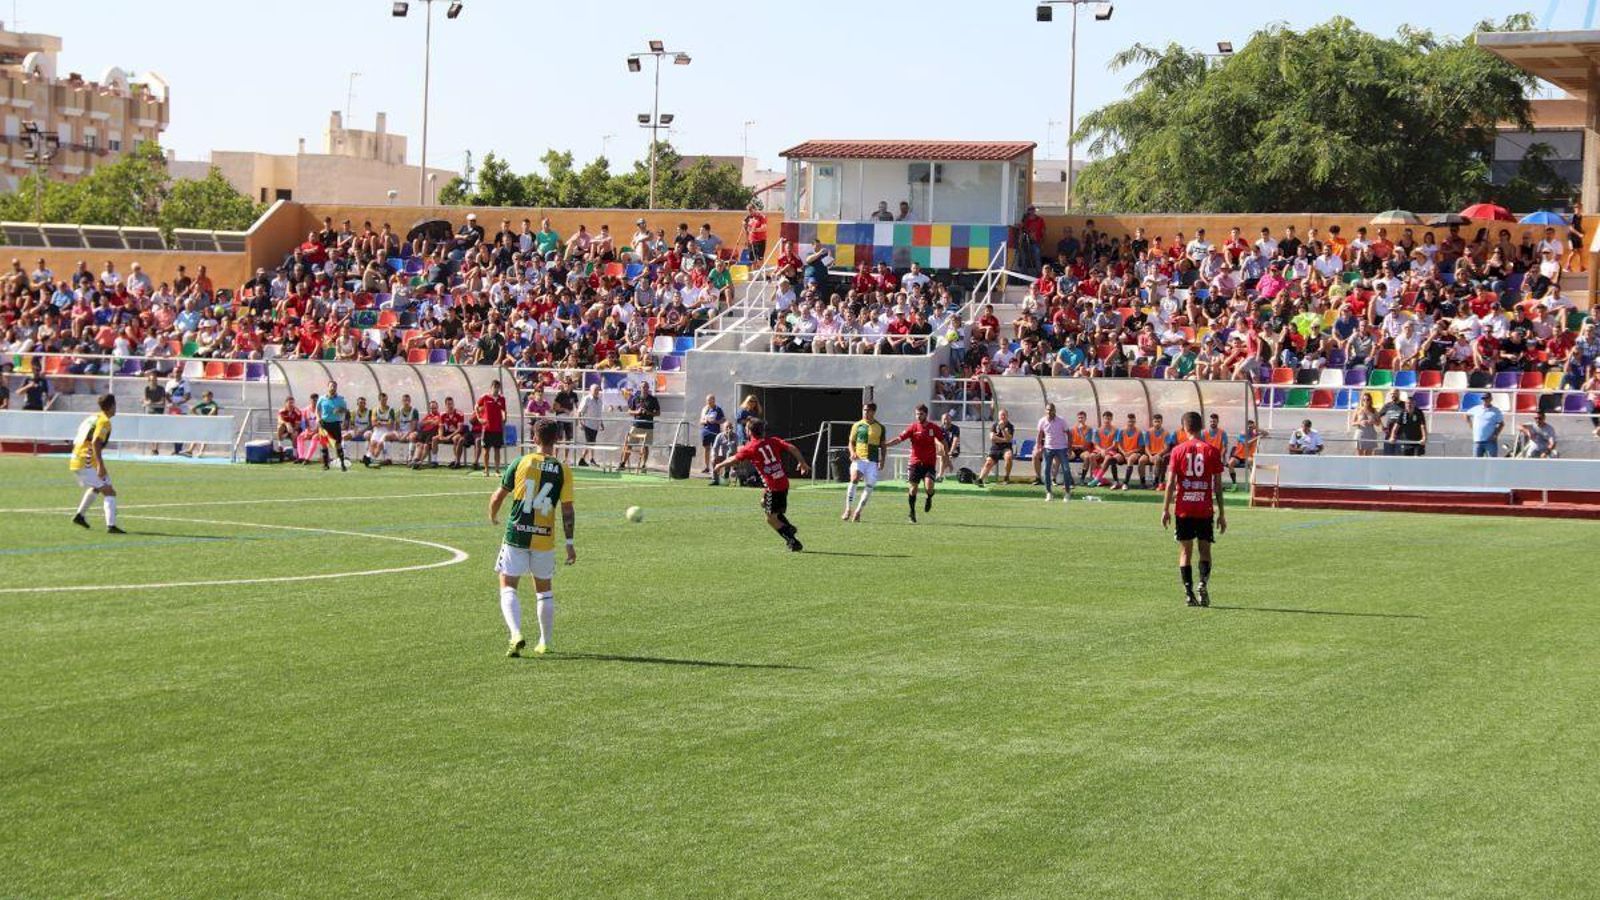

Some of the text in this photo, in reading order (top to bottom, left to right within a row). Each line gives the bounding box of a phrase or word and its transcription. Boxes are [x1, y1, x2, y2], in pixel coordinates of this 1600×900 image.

[759, 445, 776, 464] 11
[1186, 453, 1204, 477] 16
[522, 479, 553, 517] 14
